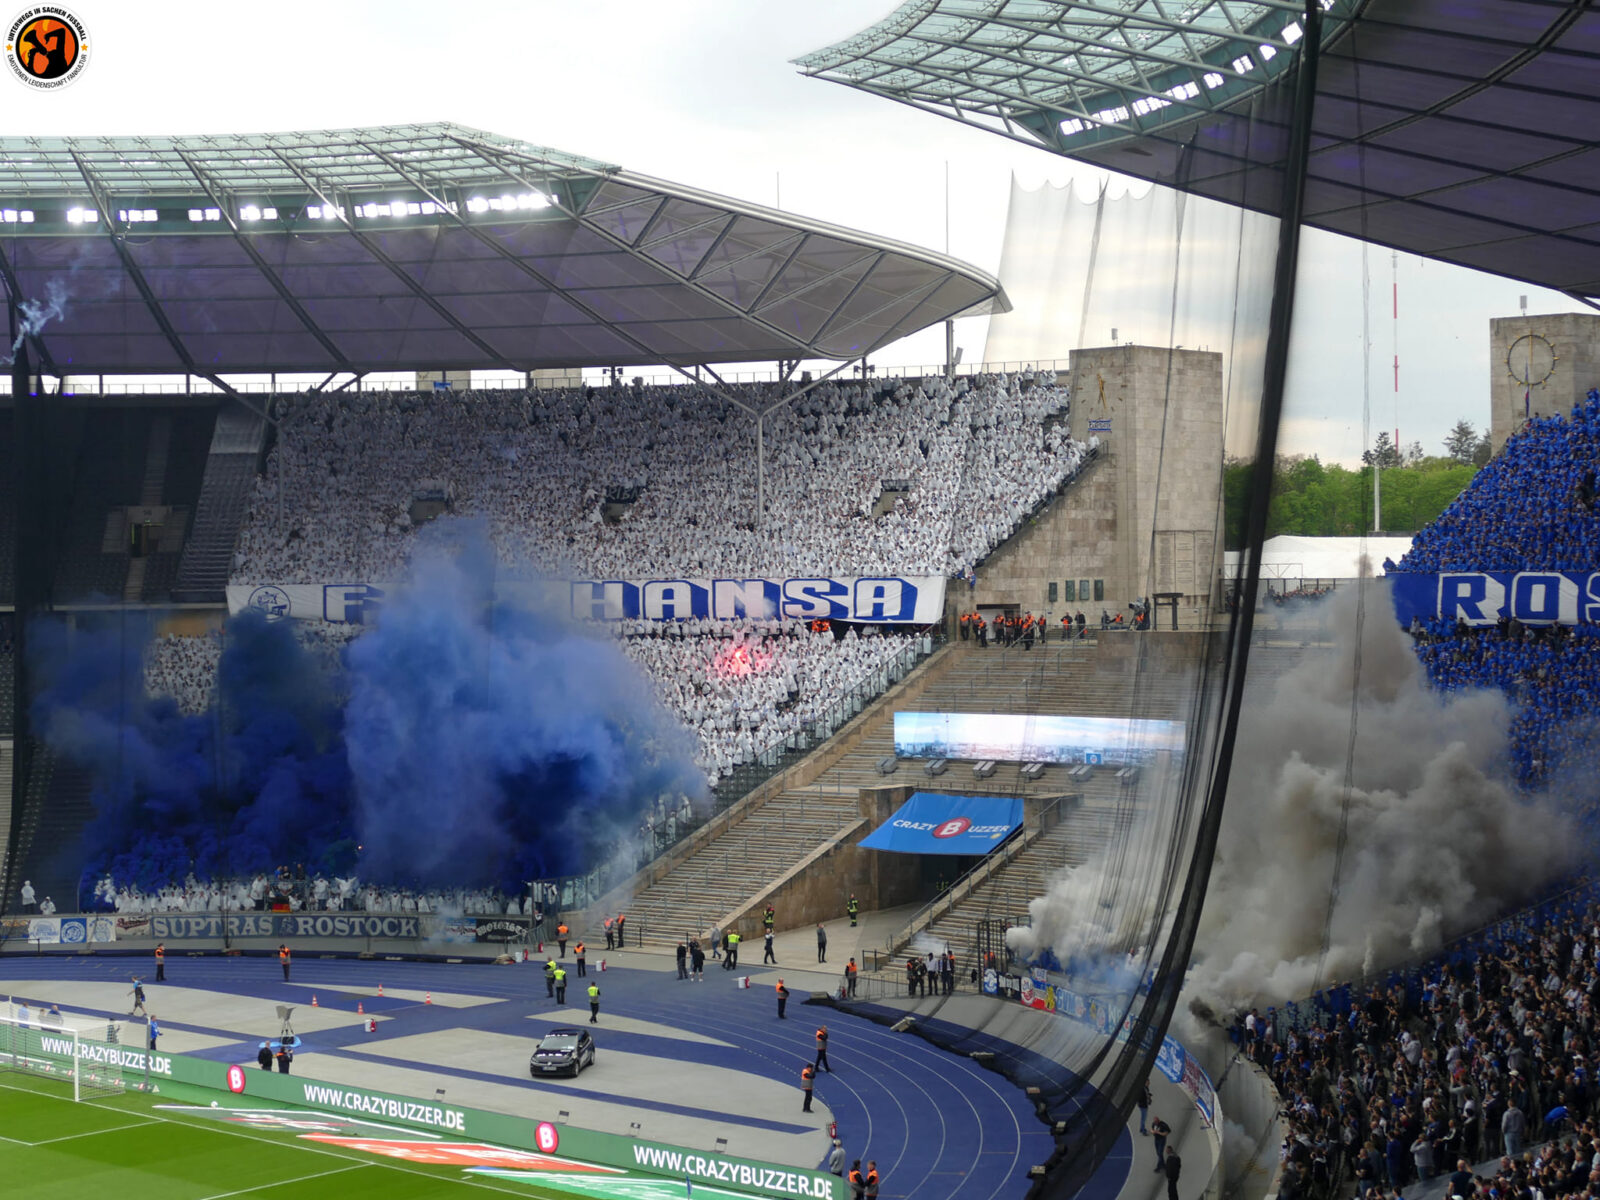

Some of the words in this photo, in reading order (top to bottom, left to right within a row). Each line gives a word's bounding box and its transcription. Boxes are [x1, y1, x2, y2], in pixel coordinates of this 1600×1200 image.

[570, 577, 918, 621] HANSA
[153, 916, 274, 938] SUPTRAS
[295, 916, 418, 937] ROSTOCK
[303, 1083, 466, 1132] WWW.CRAZYBUZZER.DE
[633, 1144, 834, 1200] WWW.CRAZYBUZZER.DE
